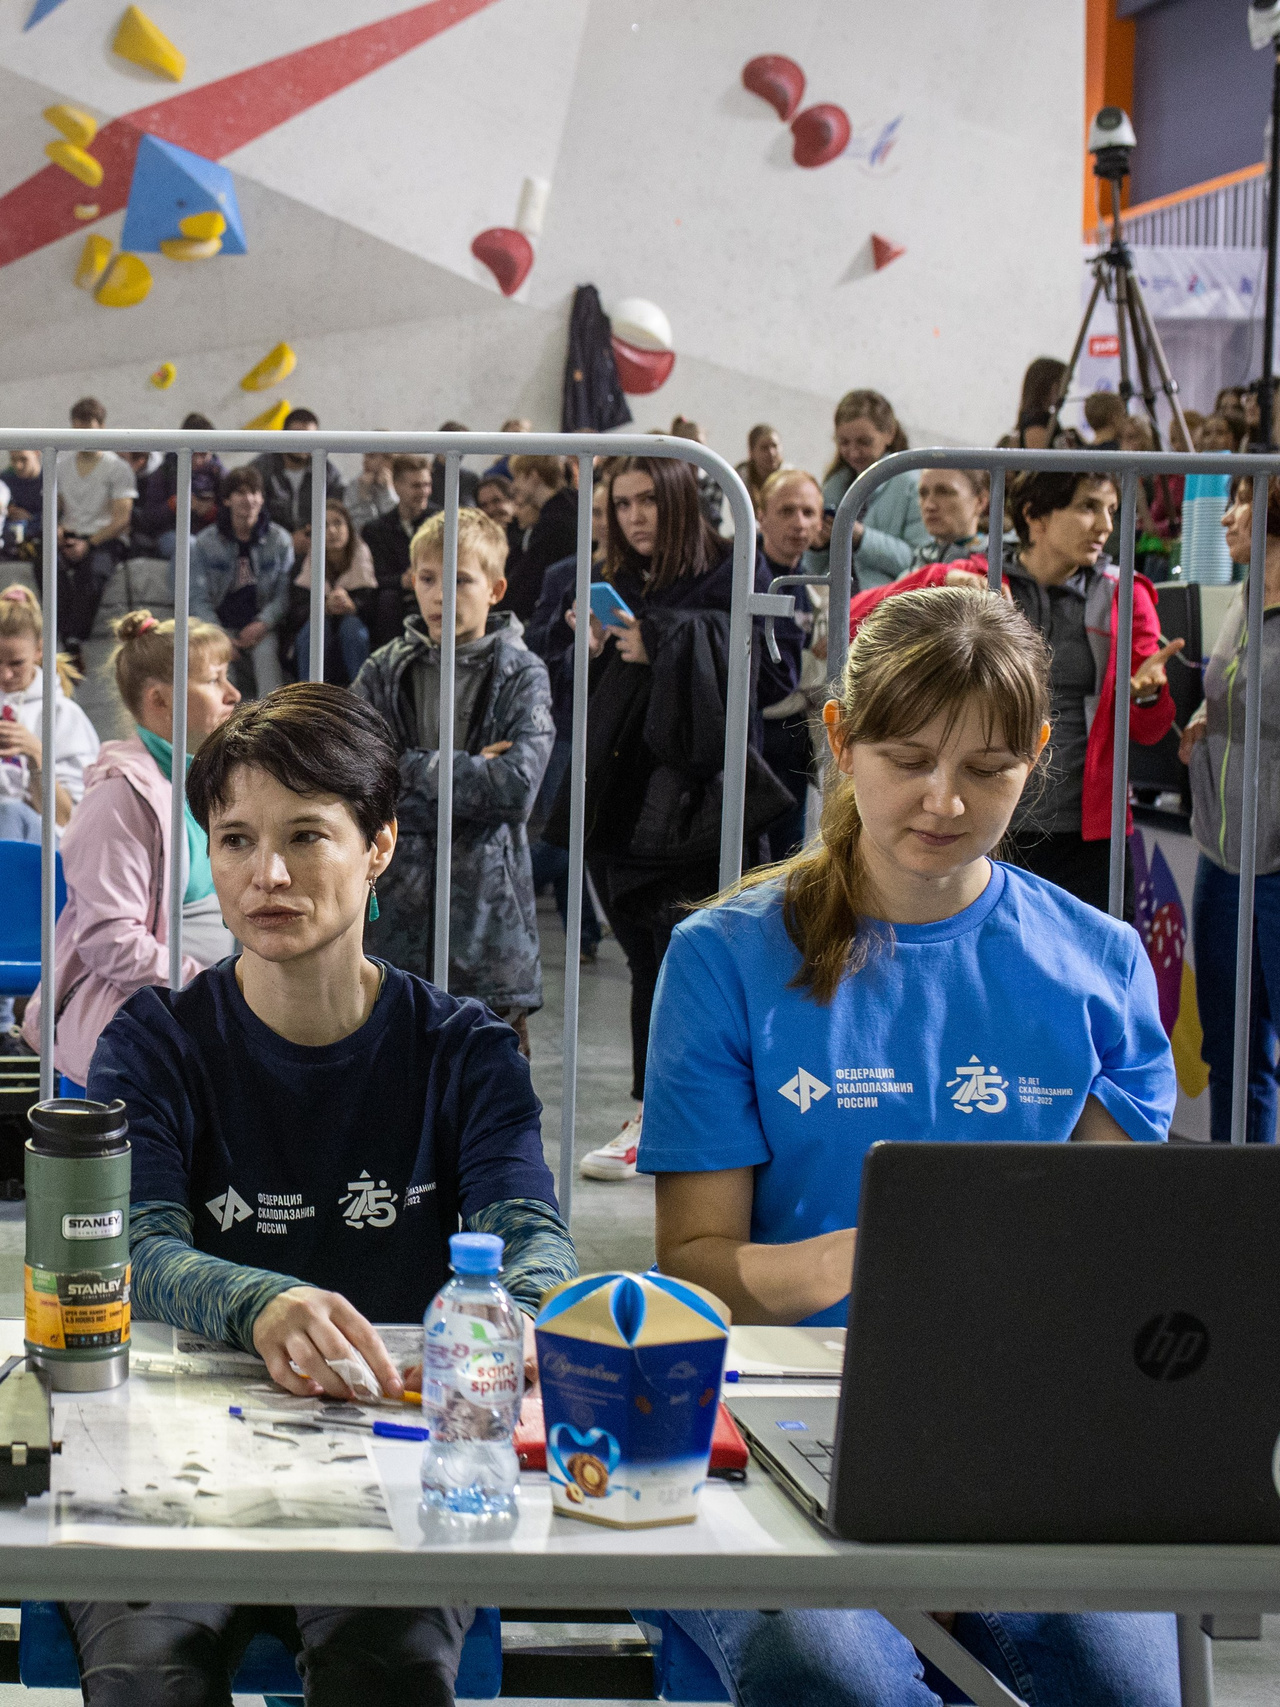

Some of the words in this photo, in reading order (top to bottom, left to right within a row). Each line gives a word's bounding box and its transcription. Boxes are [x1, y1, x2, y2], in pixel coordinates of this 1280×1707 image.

[835, 1068, 895, 1080] ФЕДЕРАЦИЯ
[1018, 1076, 1026, 1085] 75
[1028, 1077, 1040, 1085] ЛЕТ
[836, 1082, 914, 1094] СКАЛОЛАЗАНИЯ
[1018, 1086, 1074, 1096] СКАЛОЛАЗАНИЮ
[837, 1097, 878, 1109] РОССИИ
[257, 1192, 303, 1207] ФЕДЕРАЦИЯ
[257, 1206, 315, 1220] СКАЛОЛАЗАНИЯ
[68, 1214, 120, 1228] STANLEY
[256, 1221, 288, 1235] РОССИИ
[67, 1279, 121, 1295] STANLEY
[1141, 1311, 1205, 1381] hp
